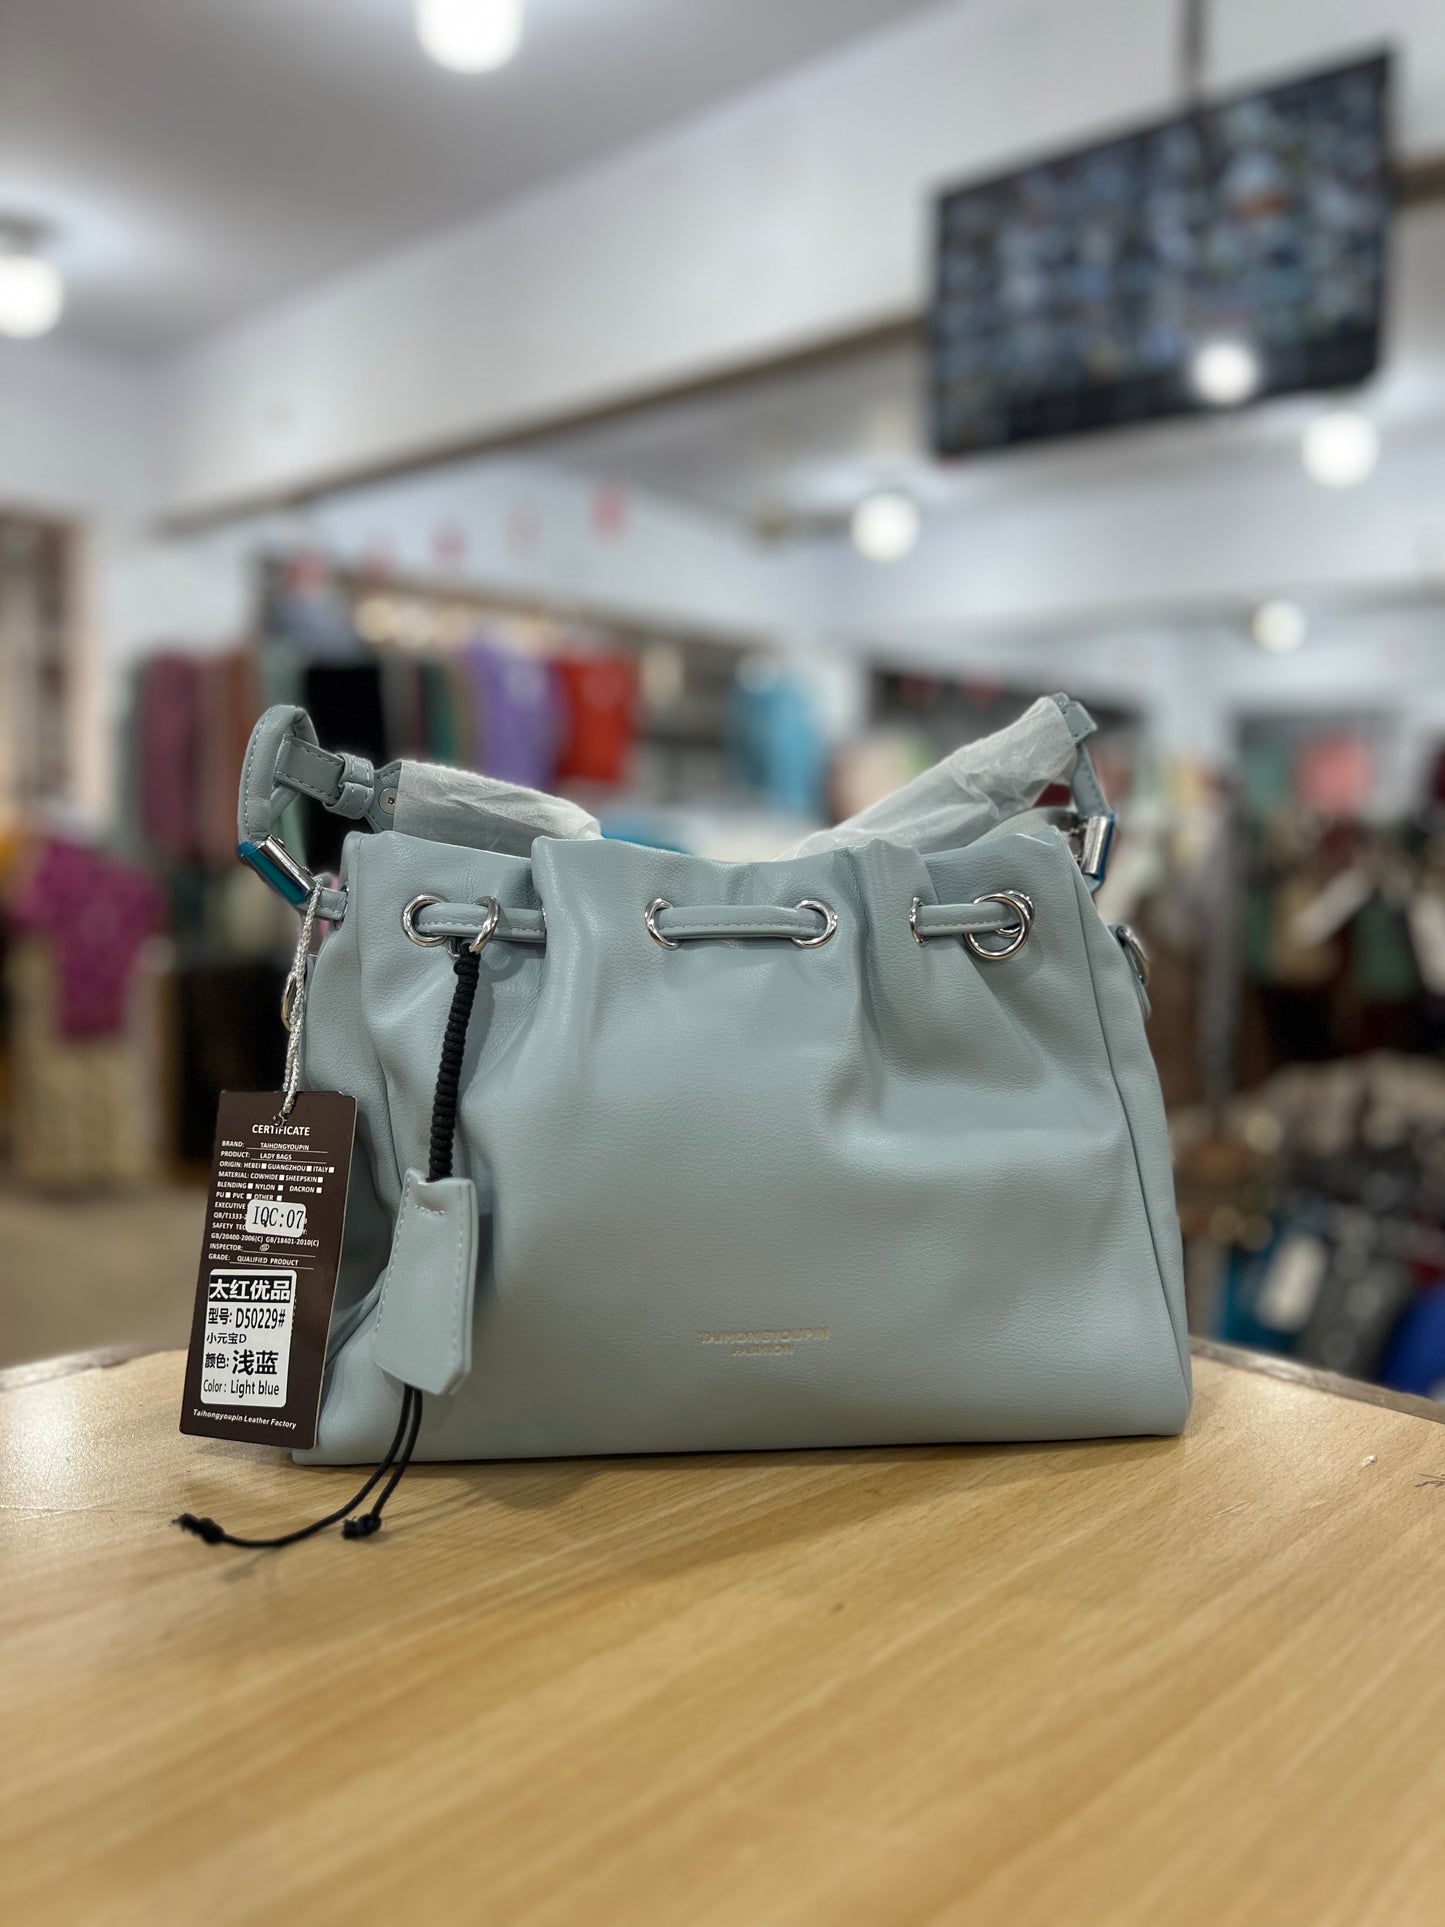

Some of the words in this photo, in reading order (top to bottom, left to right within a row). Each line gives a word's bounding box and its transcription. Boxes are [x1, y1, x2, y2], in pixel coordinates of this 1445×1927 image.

[252, 1124, 310, 1136] CERTIFICATE
[260, 1142, 310, 1151] TAIHONGYOUPIN
[220, 1150, 250, 1158] PRODUCT:
[219, 1160, 243, 1168] ORIGIN:
[267, 1163, 306, 1172] GUANGZHOU
[250, 1172, 278, 1180] COWHIDE
[285, 1174, 318, 1183] SHEEPSKIN
[217, 1181, 247, 1189] BLENDING
[289, 1185, 315, 1193] DACRON
[253, 1193, 274, 1201] OTHER
[214, 1201, 246, 1210] EXECUTIVE
[252, 1206, 304, 1229] IQC:07
[212, 1222, 234, 1230] SAFETY
[209, 1243, 243, 1251] INSPECTOR:
[208, 1253, 231, 1261] GRADE:
[236, 1255, 268, 1264] QUALIFIED
[269, 1257, 299, 1267] PRODUCT
[209, 1278, 291, 1301] 太红优品
[235, 1308, 286, 1329] D50229#
[206, 1332, 247, 1345] 小元宝D
[231, 1349, 279, 1376] 浅蓝
[230, 1380, 256, 1398] Light
[258, 1380, 280, 1396] blue
[193, 1408, 243, 1423] Taihongyoupin
[243, 1415, 270, 1425] Leather
[270, 1418, 297, 1430] Factory
